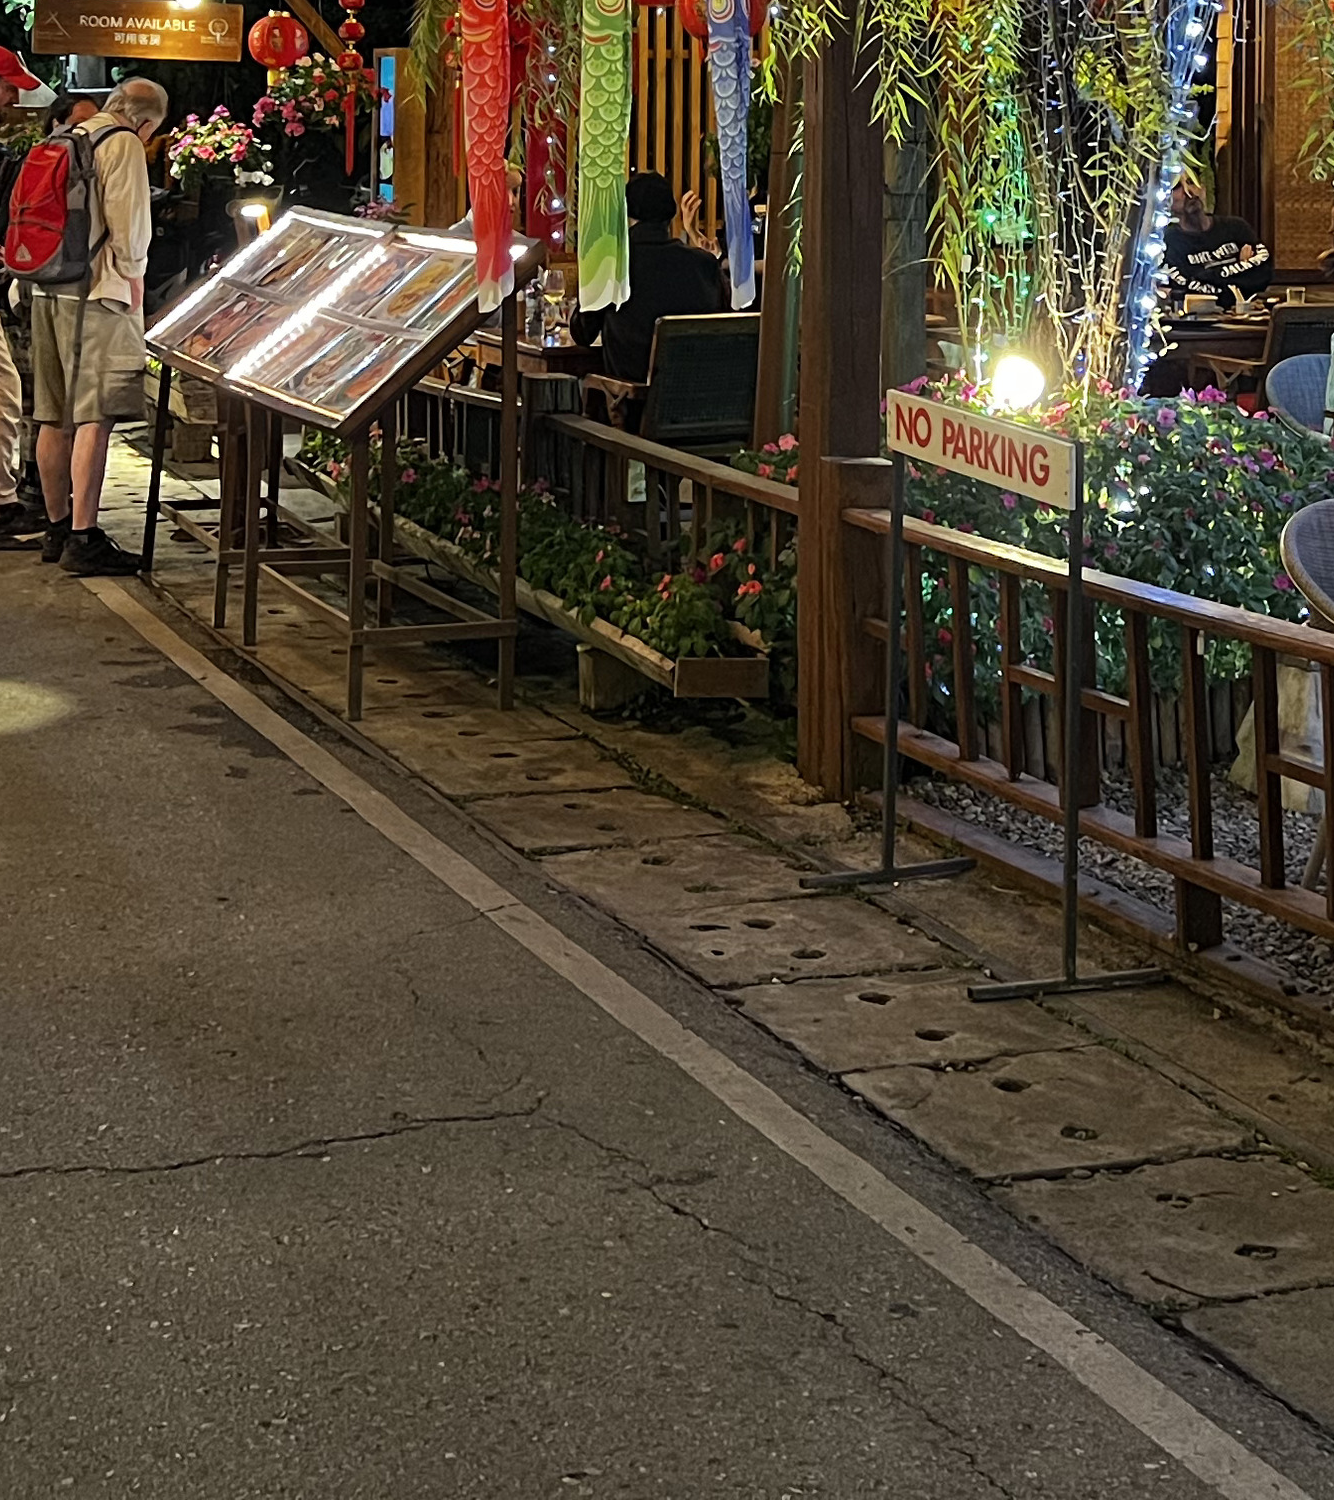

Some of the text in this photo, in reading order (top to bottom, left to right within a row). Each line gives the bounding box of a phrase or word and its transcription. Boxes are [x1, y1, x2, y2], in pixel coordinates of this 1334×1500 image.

[79, 14, 196, 33] ROOM AVAILABLE
[895, 402, 1051, 487] NO PARKING
